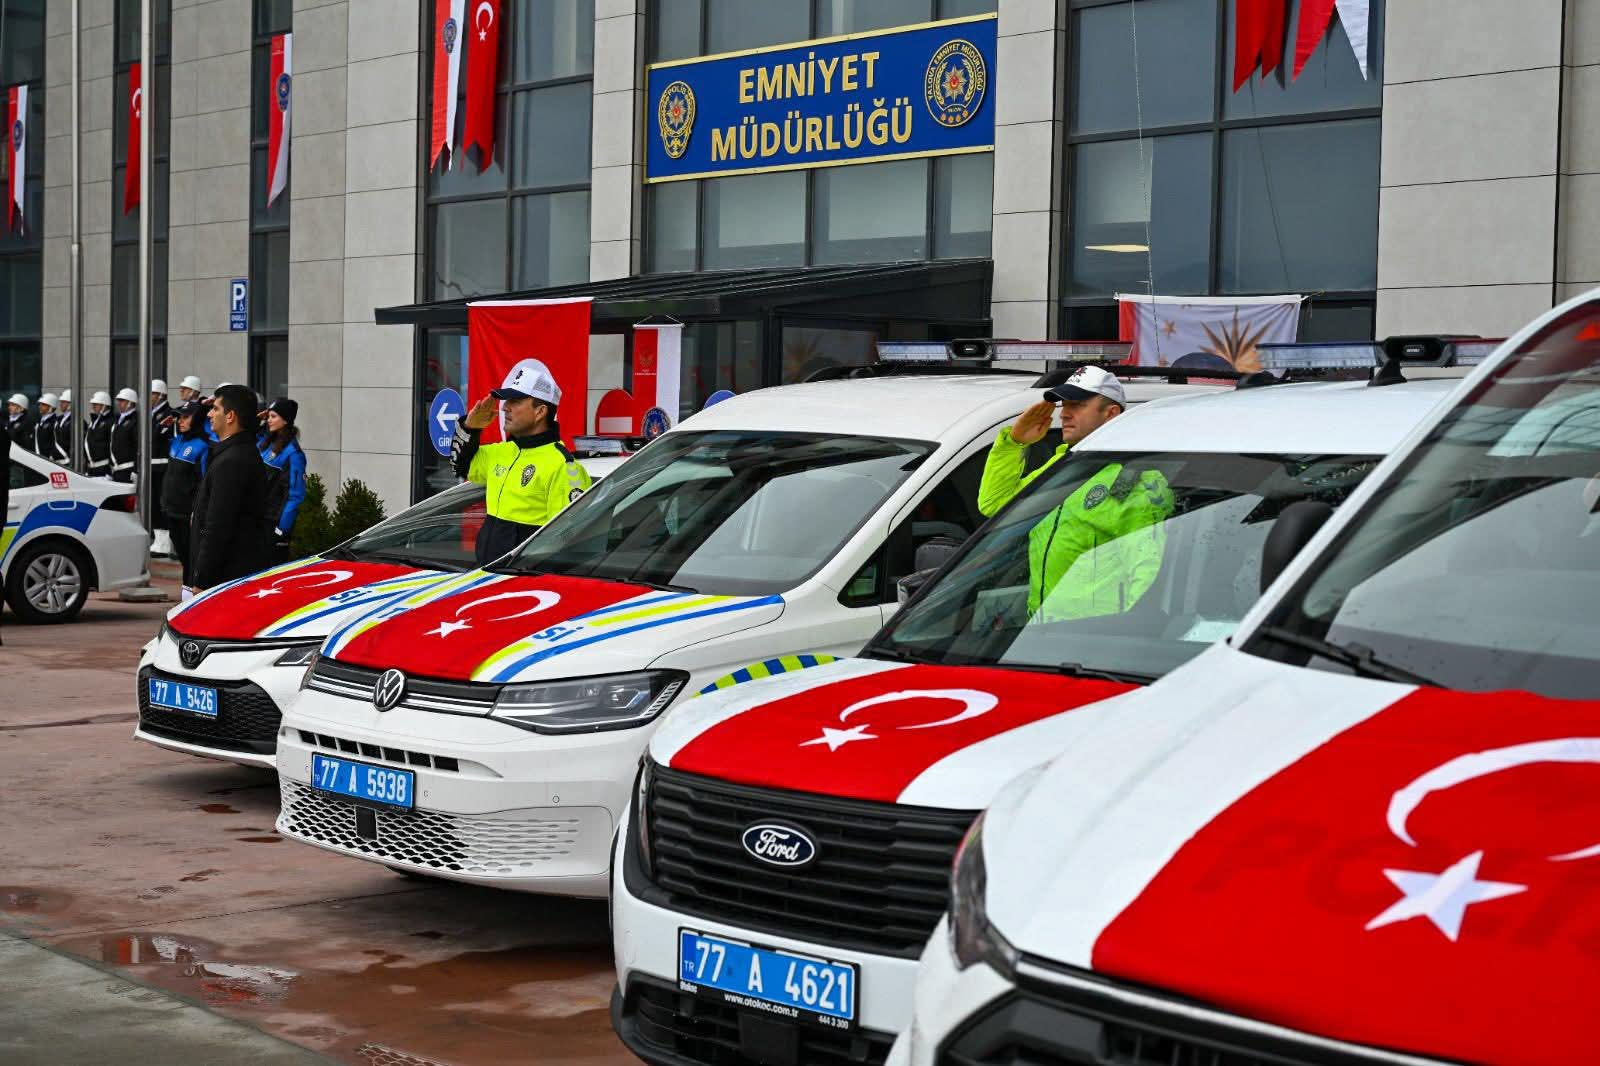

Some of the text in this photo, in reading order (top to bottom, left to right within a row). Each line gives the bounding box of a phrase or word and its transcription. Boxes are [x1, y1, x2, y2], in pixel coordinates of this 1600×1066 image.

[739, 51, 880, 104] EMNİYET
[711, 97, 913, 162] MÜDÜRLÜĞÜ
[233, 283, 246, 311] P
[155, 681, 213, 711] 77 A 5426
[321, 760, 340, 788] 77
[348, 765, 357, 793] A
[367, 768, 407, 803] 5938
[754, 829, 801, 861] Ford
[684, 940, 848, 1013] TR 77 A 4621
